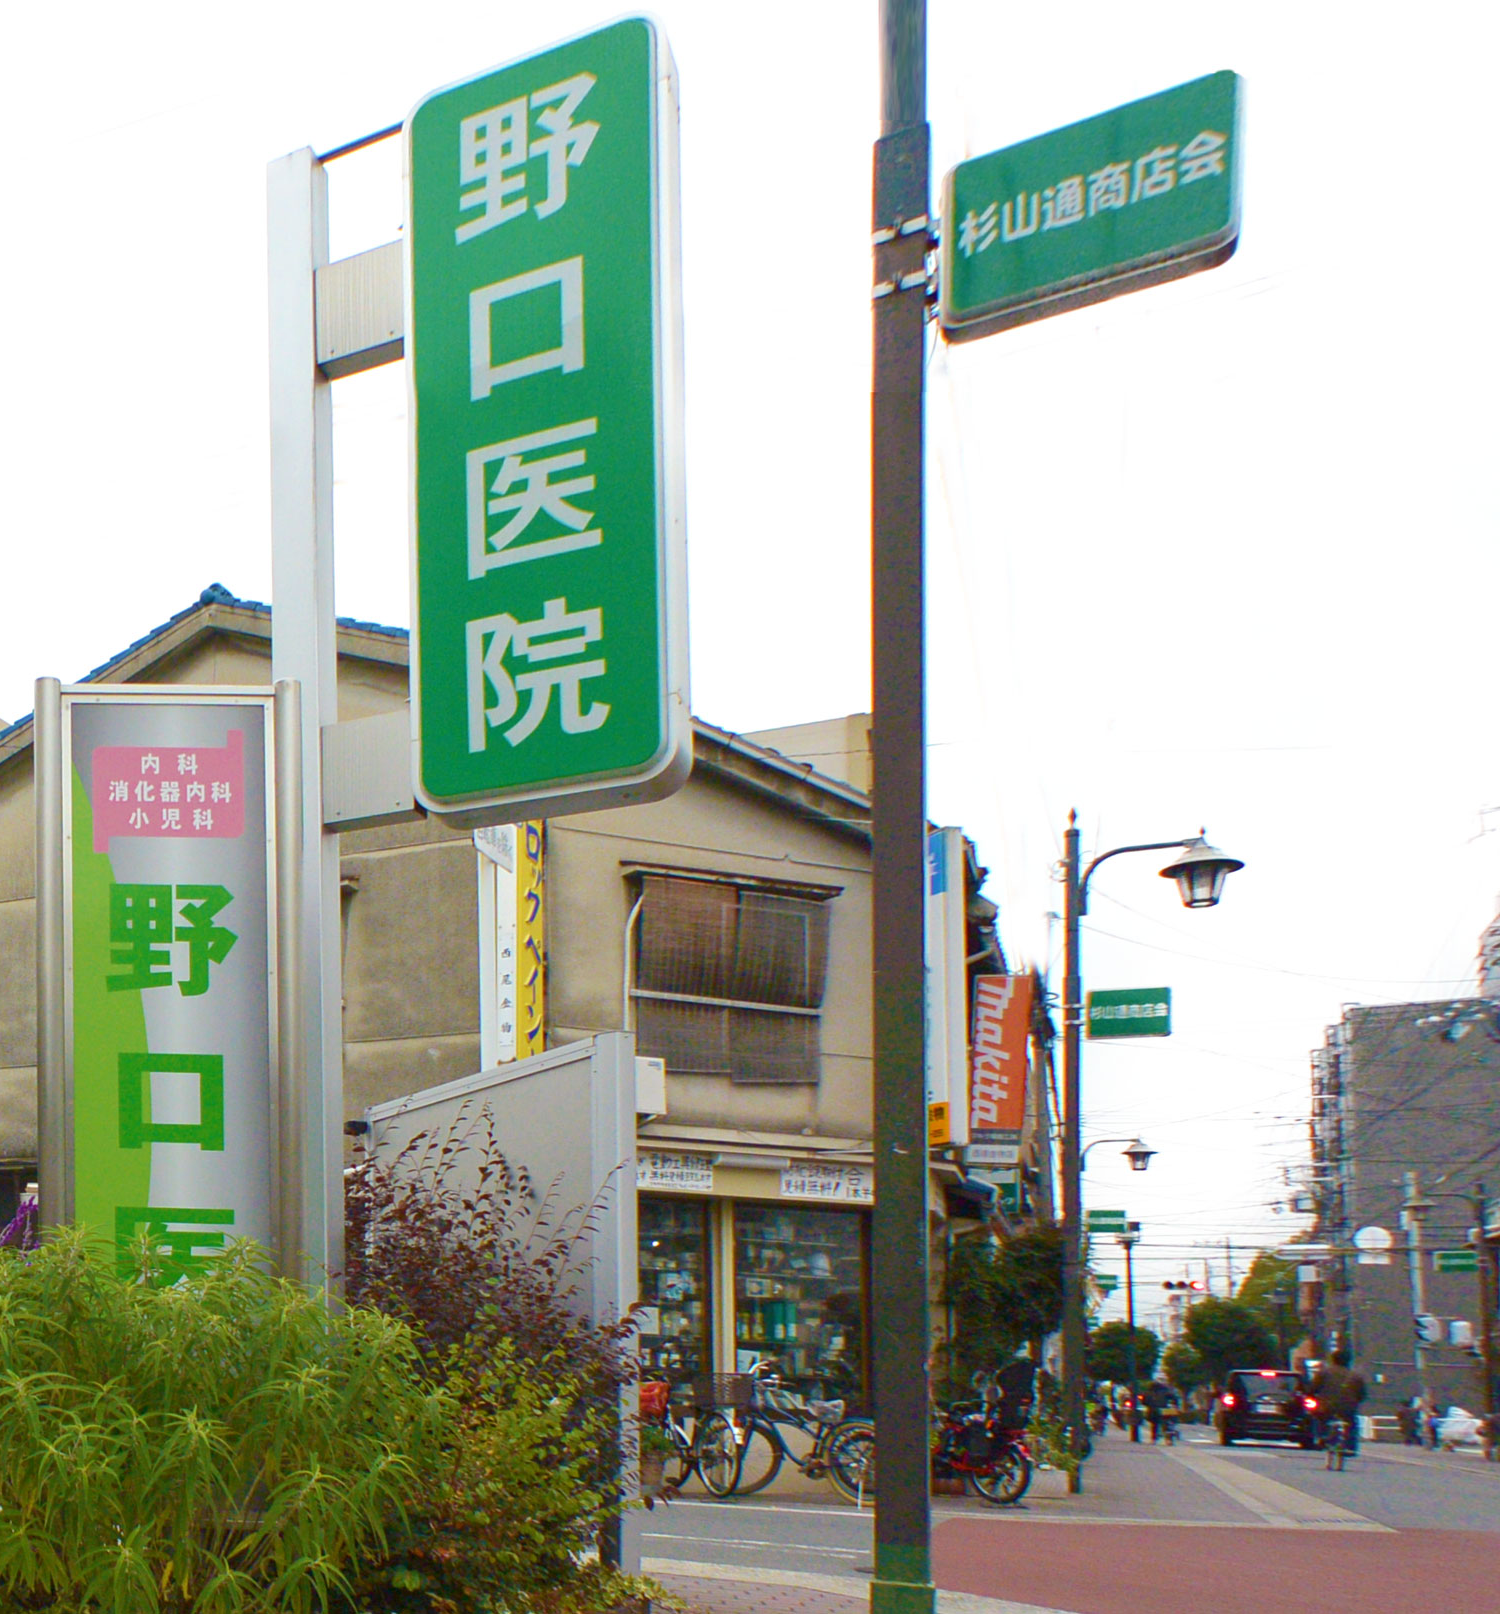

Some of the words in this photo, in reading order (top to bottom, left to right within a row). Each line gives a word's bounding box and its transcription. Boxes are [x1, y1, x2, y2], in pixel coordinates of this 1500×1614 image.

[957, 130, 1228, 258] 杉山通商店会
[455, 72, 611, 756] 野口医院
[108, 780, 232, 803] 消化器内科
[141, 753, 198, 775] 内科
[129, 808, 213, 830] 小児科
[523, 822, 542, 1057] ロックペイン
